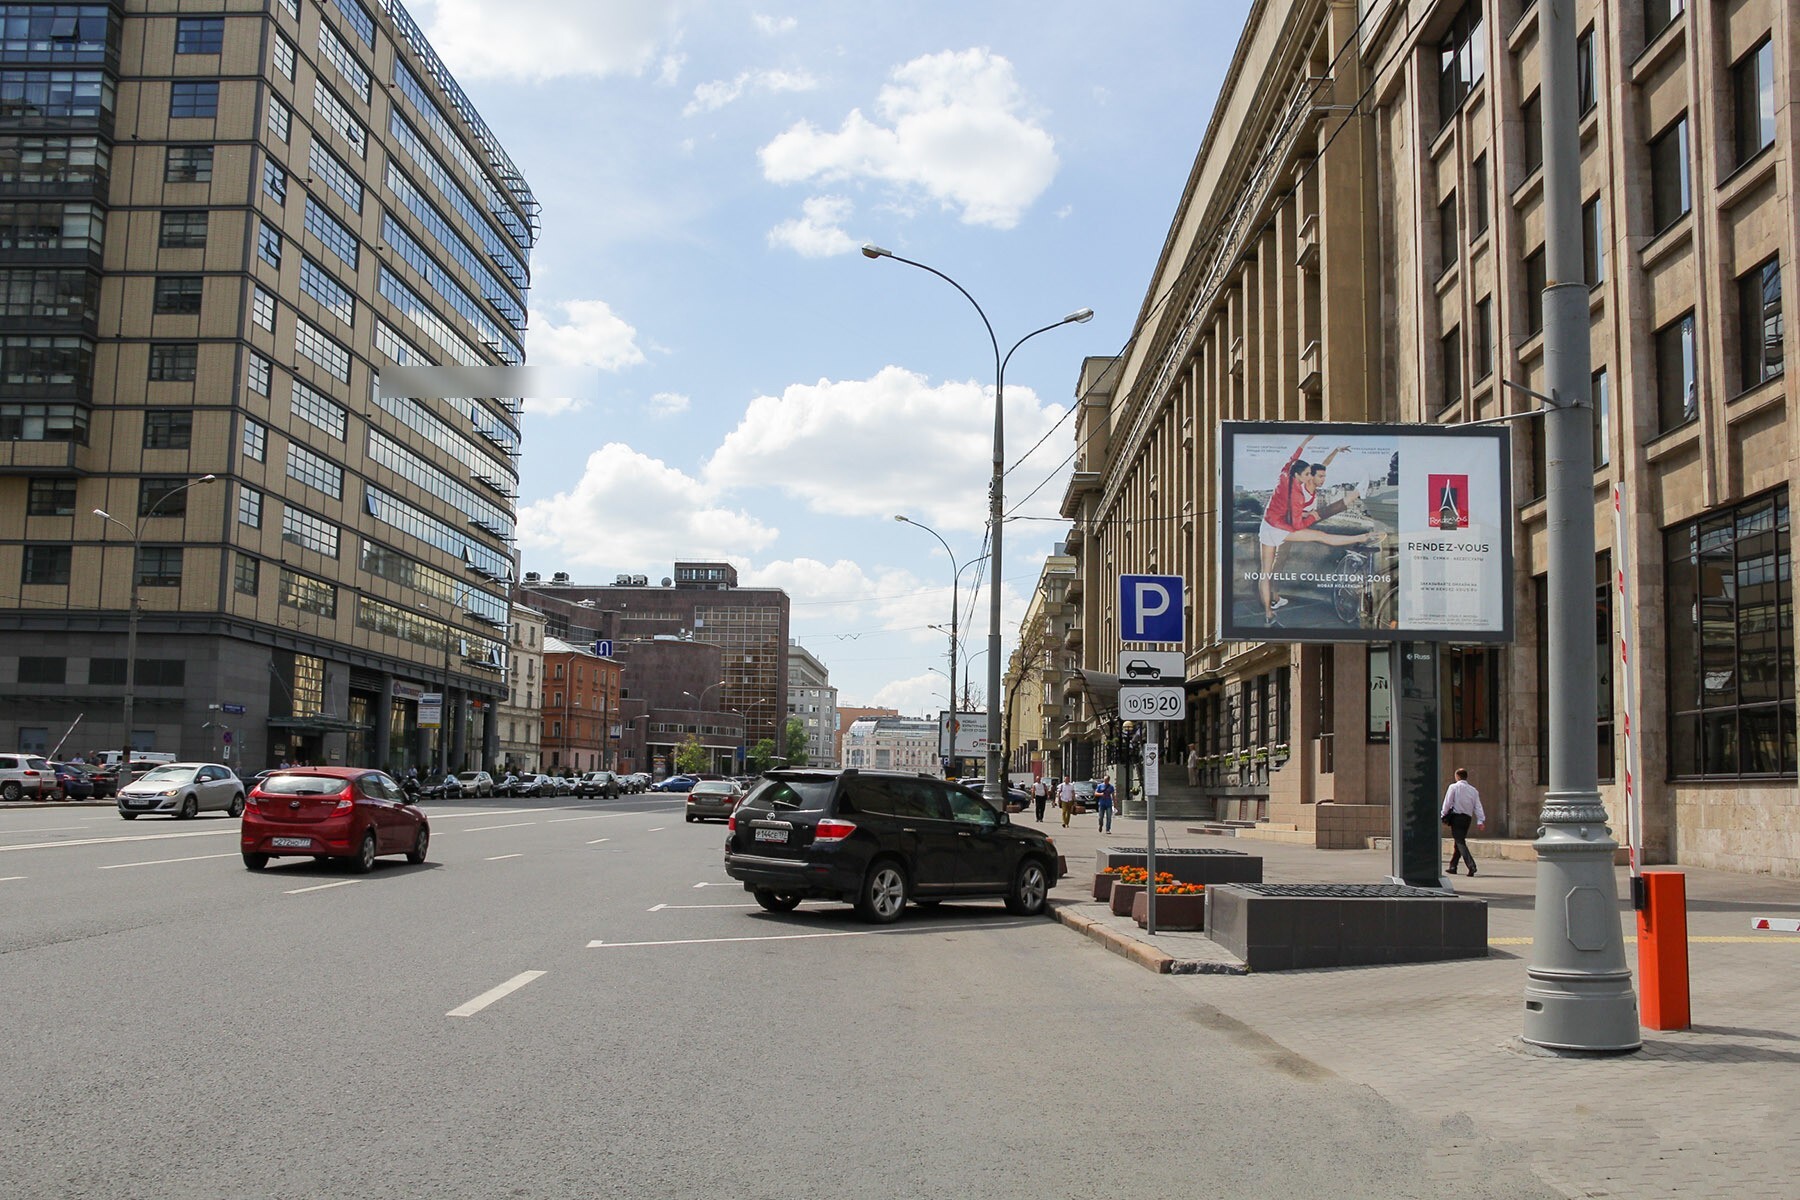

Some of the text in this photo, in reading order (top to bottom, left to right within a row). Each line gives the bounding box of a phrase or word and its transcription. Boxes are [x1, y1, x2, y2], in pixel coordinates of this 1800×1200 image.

[1408, 542, 1489, 553] RENDEZ-VOUS
[1244, 572, 1391, 583] NOUVELLE COLLECTION 2016
[1135, 582, 1170, 634] P
[1128, 697, 1178, 710] 10 15 20
